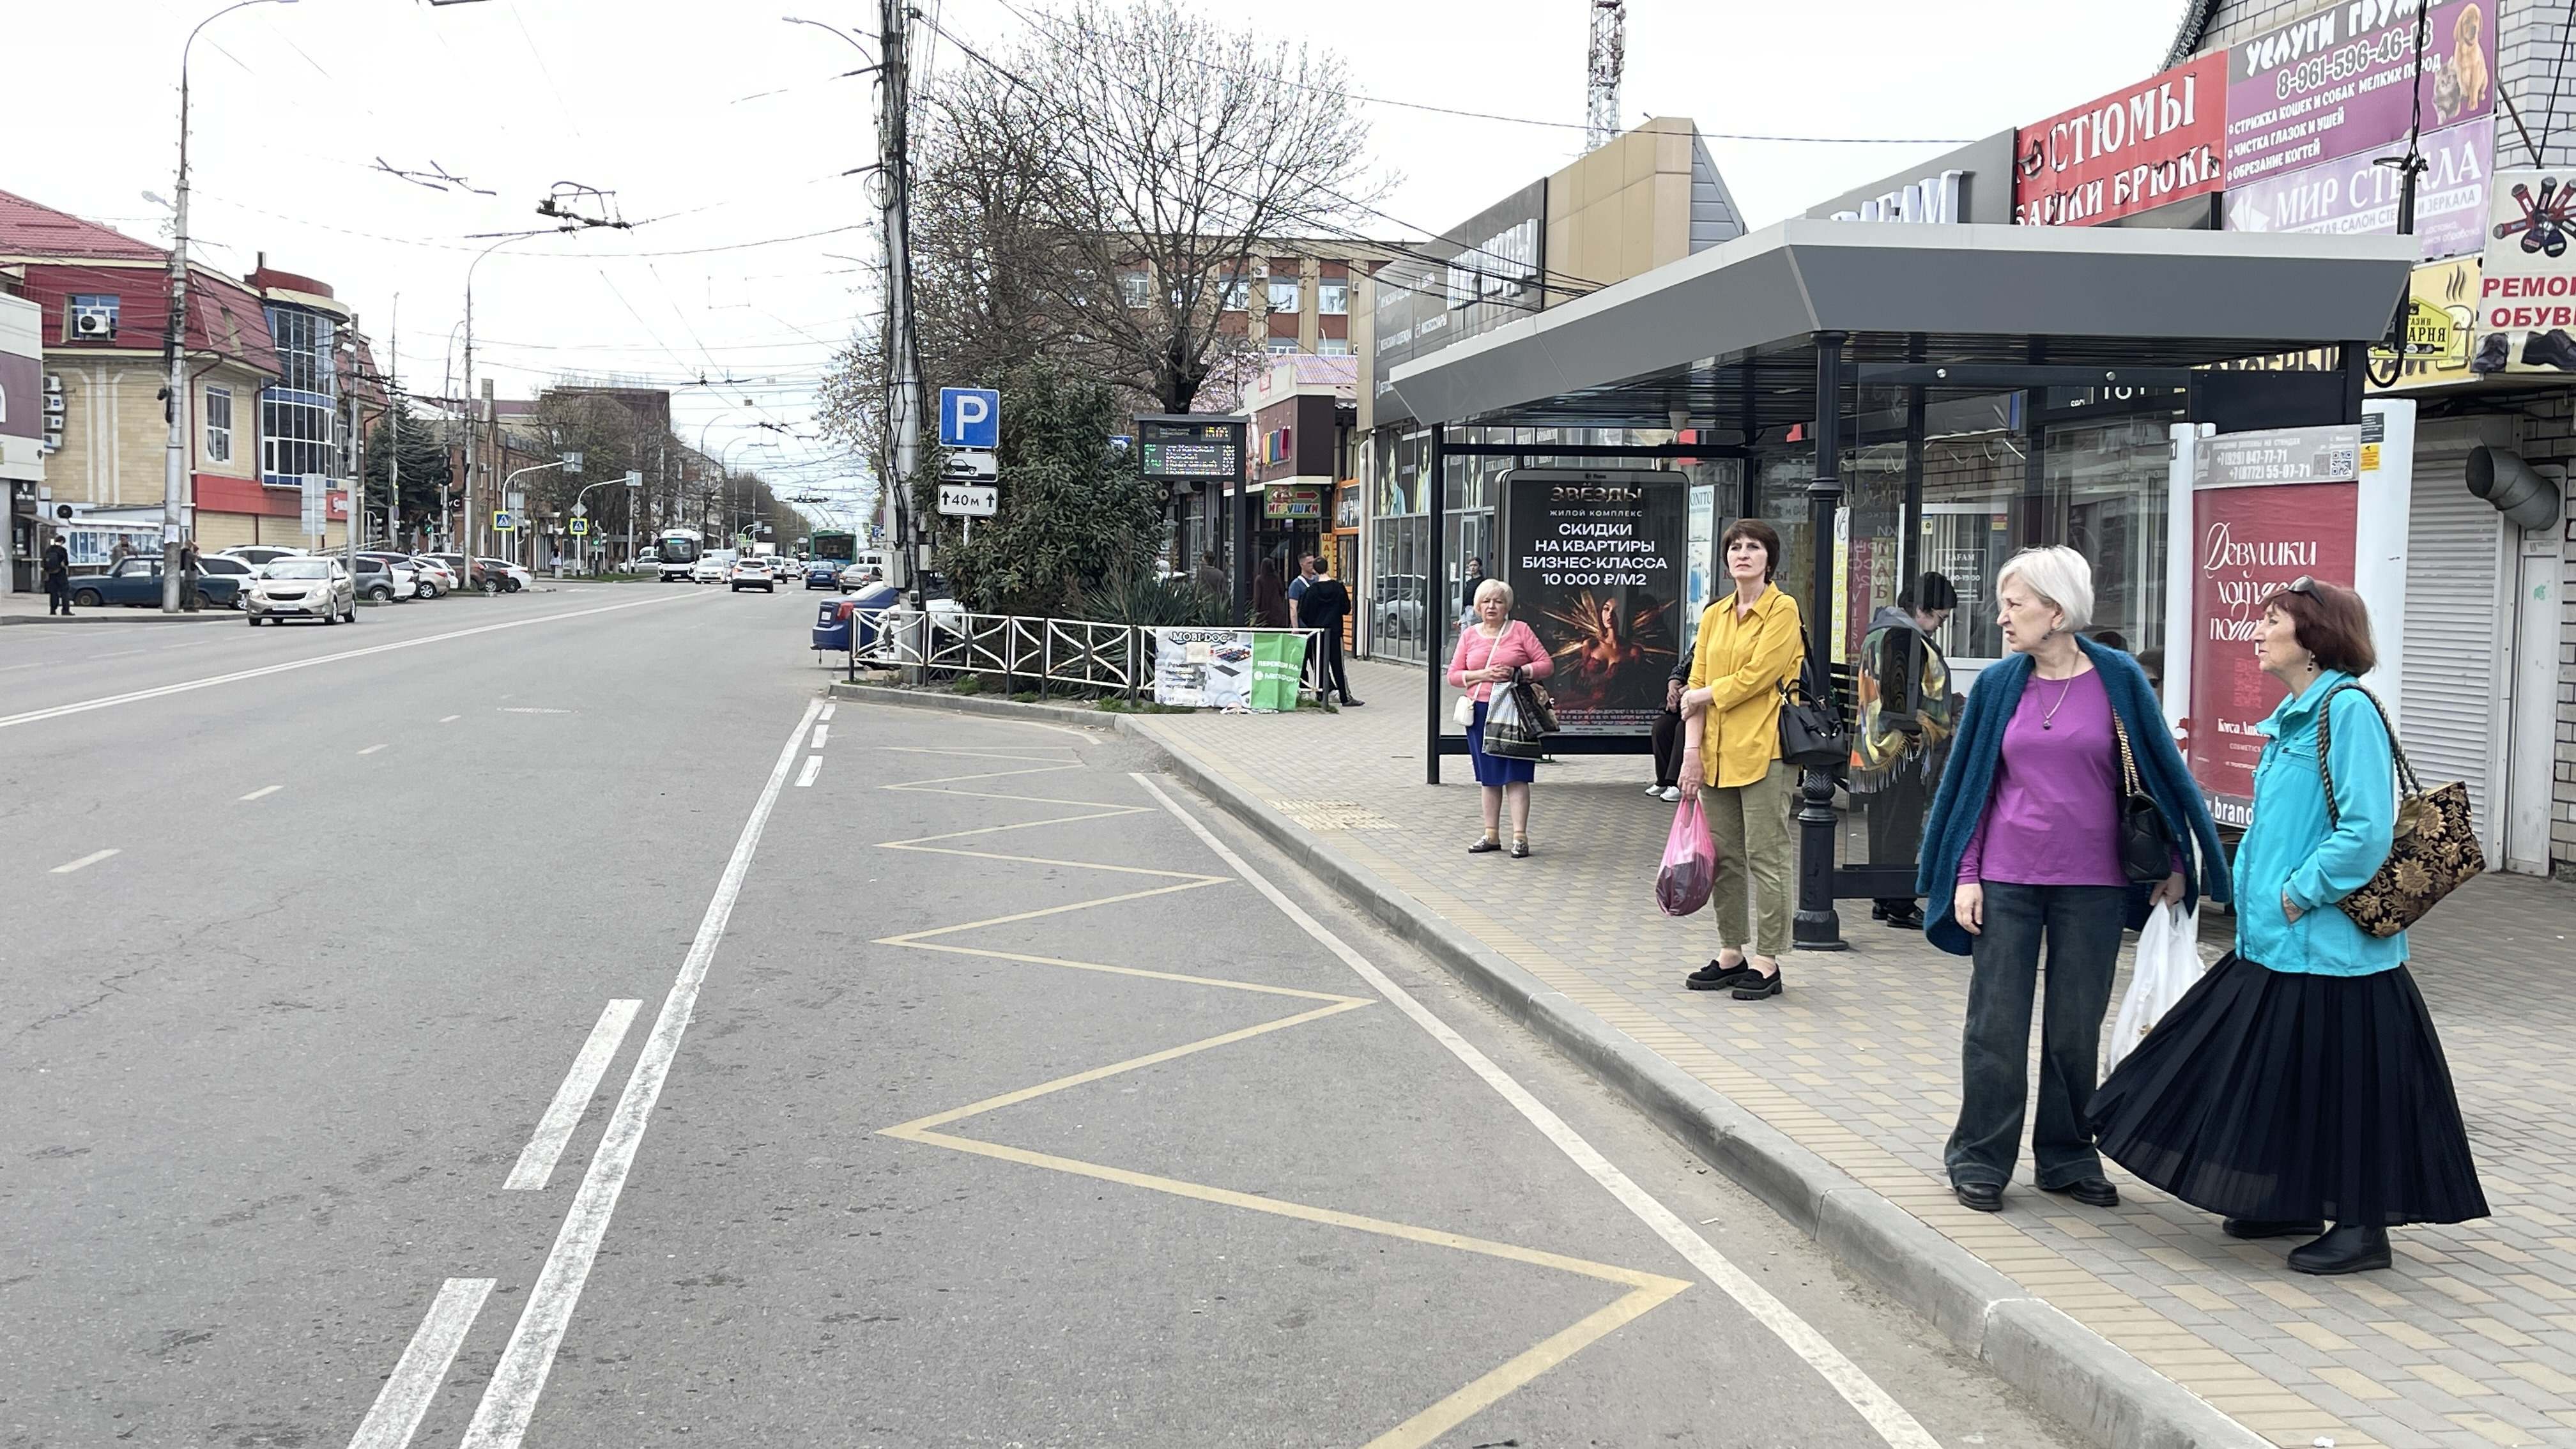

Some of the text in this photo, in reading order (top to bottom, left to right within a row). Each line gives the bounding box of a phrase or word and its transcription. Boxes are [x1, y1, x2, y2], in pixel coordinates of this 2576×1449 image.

[2246, 0, 2442, 77] УСЛУГИ ГРУМ
[2234, 53, 2441, 135] СТРИЖКА КОШЕК И СОБАК МЕЛКИХ ПООД
[2018, 72, 2196, 181] СТЮМЫ
[2234, 106, 2345, 157] ЧИСТКА ГЛАЗОК И УШЕЙ
[2233, 137, 2321, 180] ОБРЕЗАНИЕ КОГТЕЙ
[2274, 178, 2338, 227] МИР
[2418, 204, 2425, 215] И
[2427, 194, 2476, 213] ЗЕРКАЛА
[2407, 326, 2446, 342] АРНЯ
[956, 395, 988, 440] P
[2266, 464, 2312, 479] 55-07-71
[1550, 483, 1643, 503] ЗВЁЗДЫ
[1690, 491, 1713, 506] ONITO
[1268, 503, 1319, 515] ИГРУШКИ
[1558, 523, 1632, 537] СКИДКИ
[1535, 540, 1655, 553] НА КВАРТИРЫ
[2204, 522, 2317, 579] Девушки
[1522, 556, 1668, 569] БИЗНЕС-КЛАССА
[1542, 573, 1561, 585] 10
[1565, 574, 1600, 585] 000
[2210, 599, 2264, 642] пода
